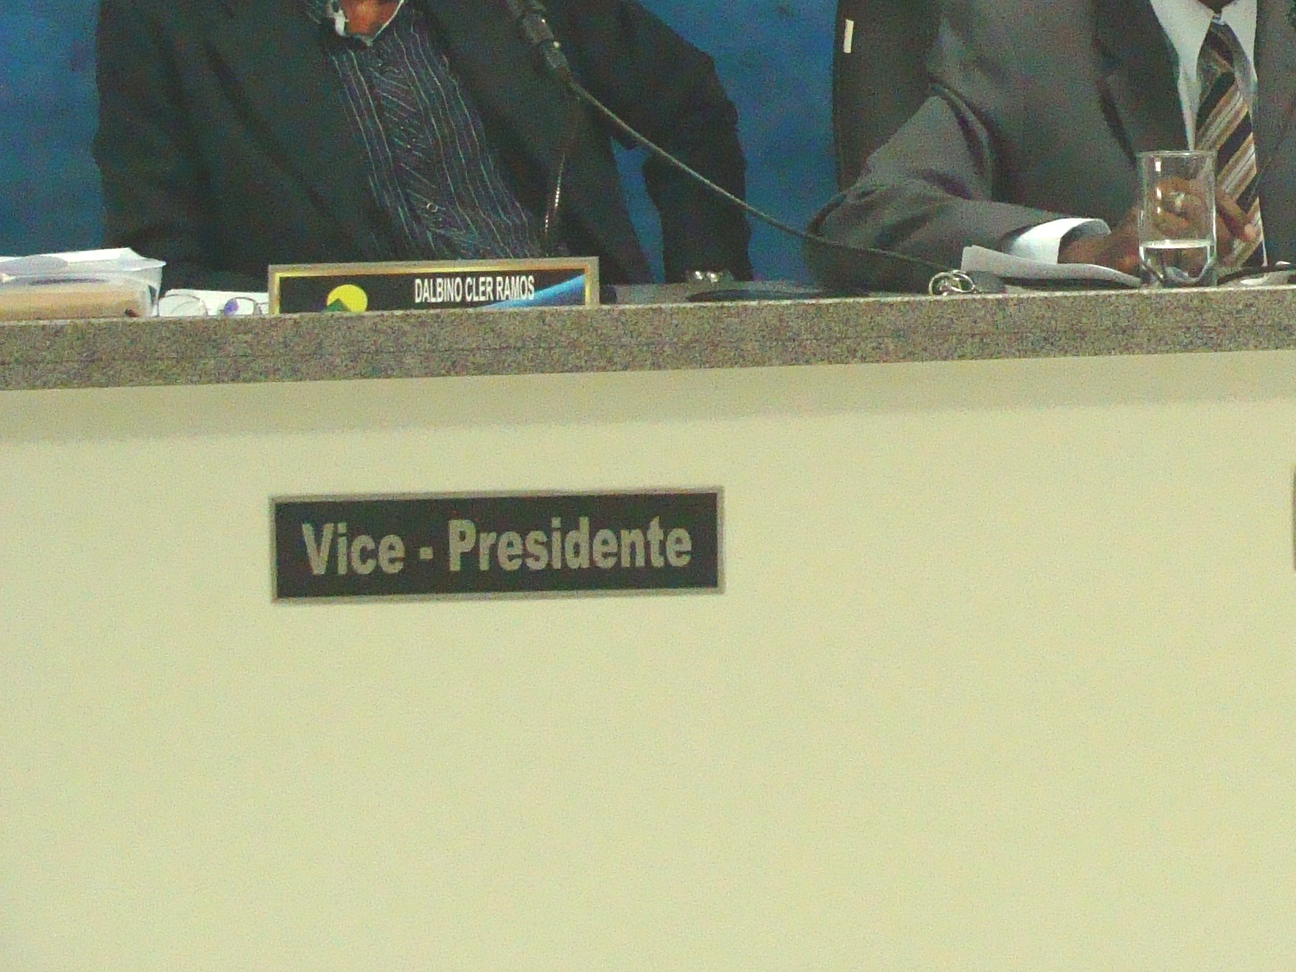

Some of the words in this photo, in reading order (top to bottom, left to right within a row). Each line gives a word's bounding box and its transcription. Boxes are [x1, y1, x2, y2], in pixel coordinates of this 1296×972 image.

[414, 277, 463, 303] DALBINO
[465, 276, 493, 301] CLER
[496, 275, 535, 300] RAMOS
[302, 522, 405, 575] Vice
[448, 515, 692, 572] Presidente
